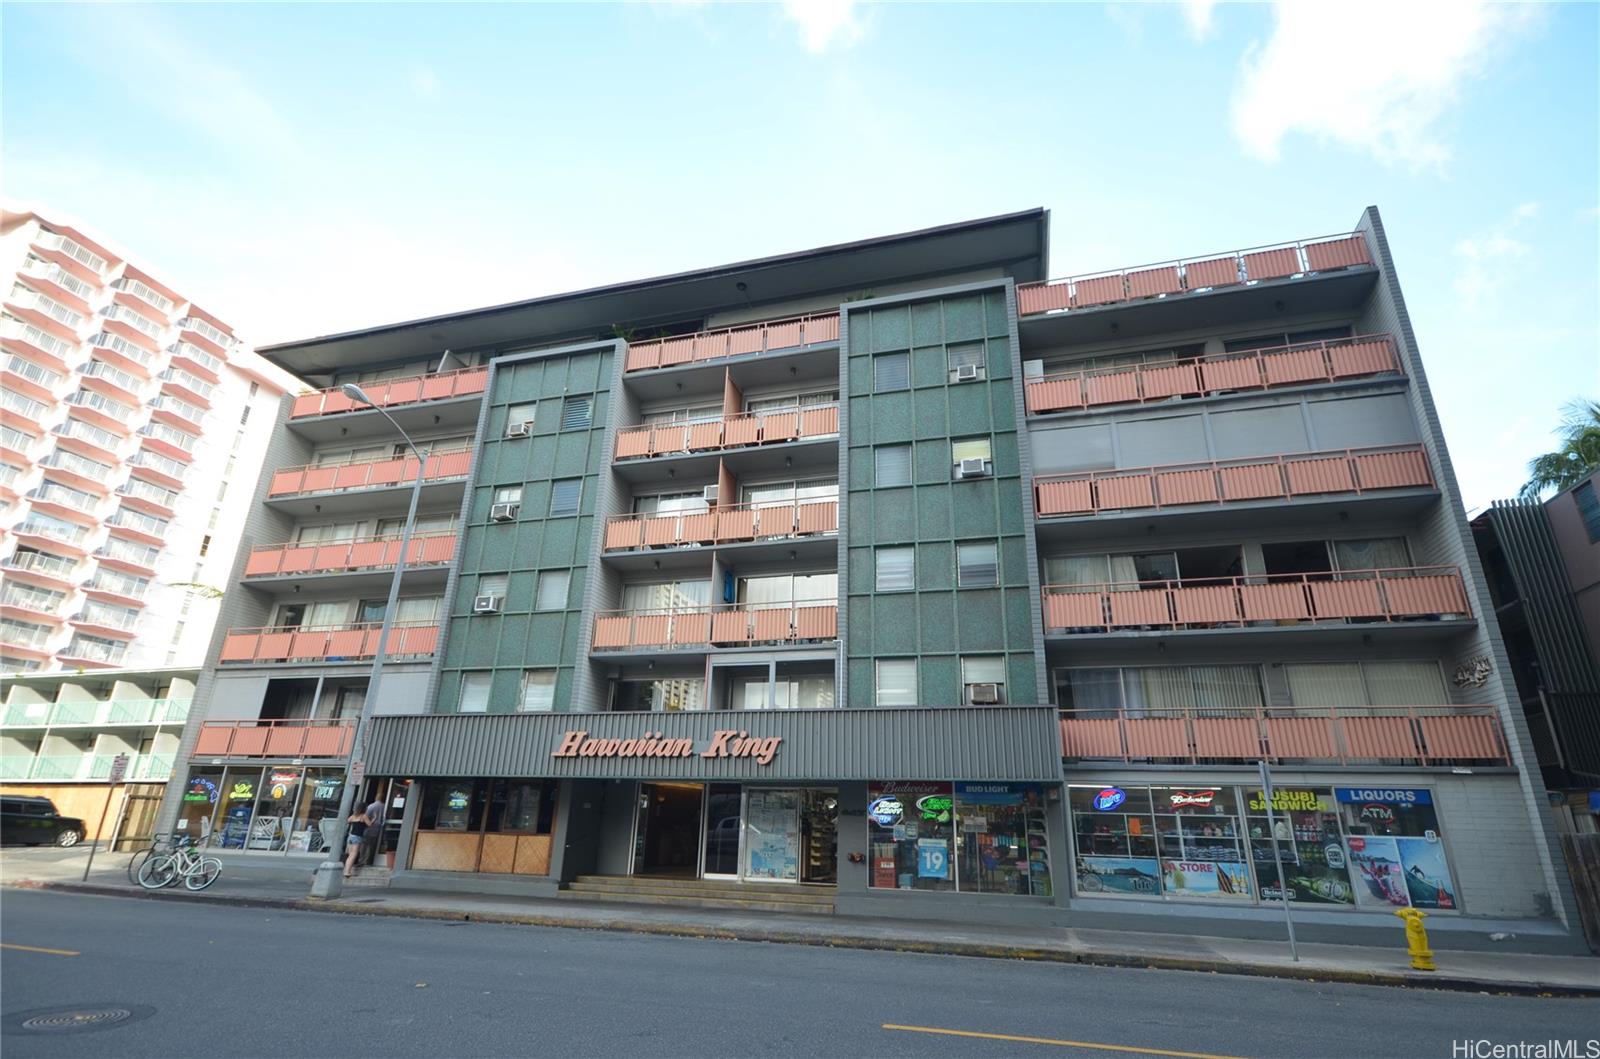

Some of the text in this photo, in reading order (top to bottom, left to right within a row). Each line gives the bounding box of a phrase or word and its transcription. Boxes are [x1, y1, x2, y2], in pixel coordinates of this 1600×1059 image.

[551, 730, 782, 765] Hawaiian King
[882, 781, 939, 793] Budweiser
[965, 785, 1009, 793] BUD LIGHT
[1350, 789, 1416, 802] LIQUORS
[1249, 800, 1328, 812] SANDWICH
[1361, 807, 1393, 819] ATM
[923, 851, 944, 870] 19
[1180, 863, 1213, 873] STORE
